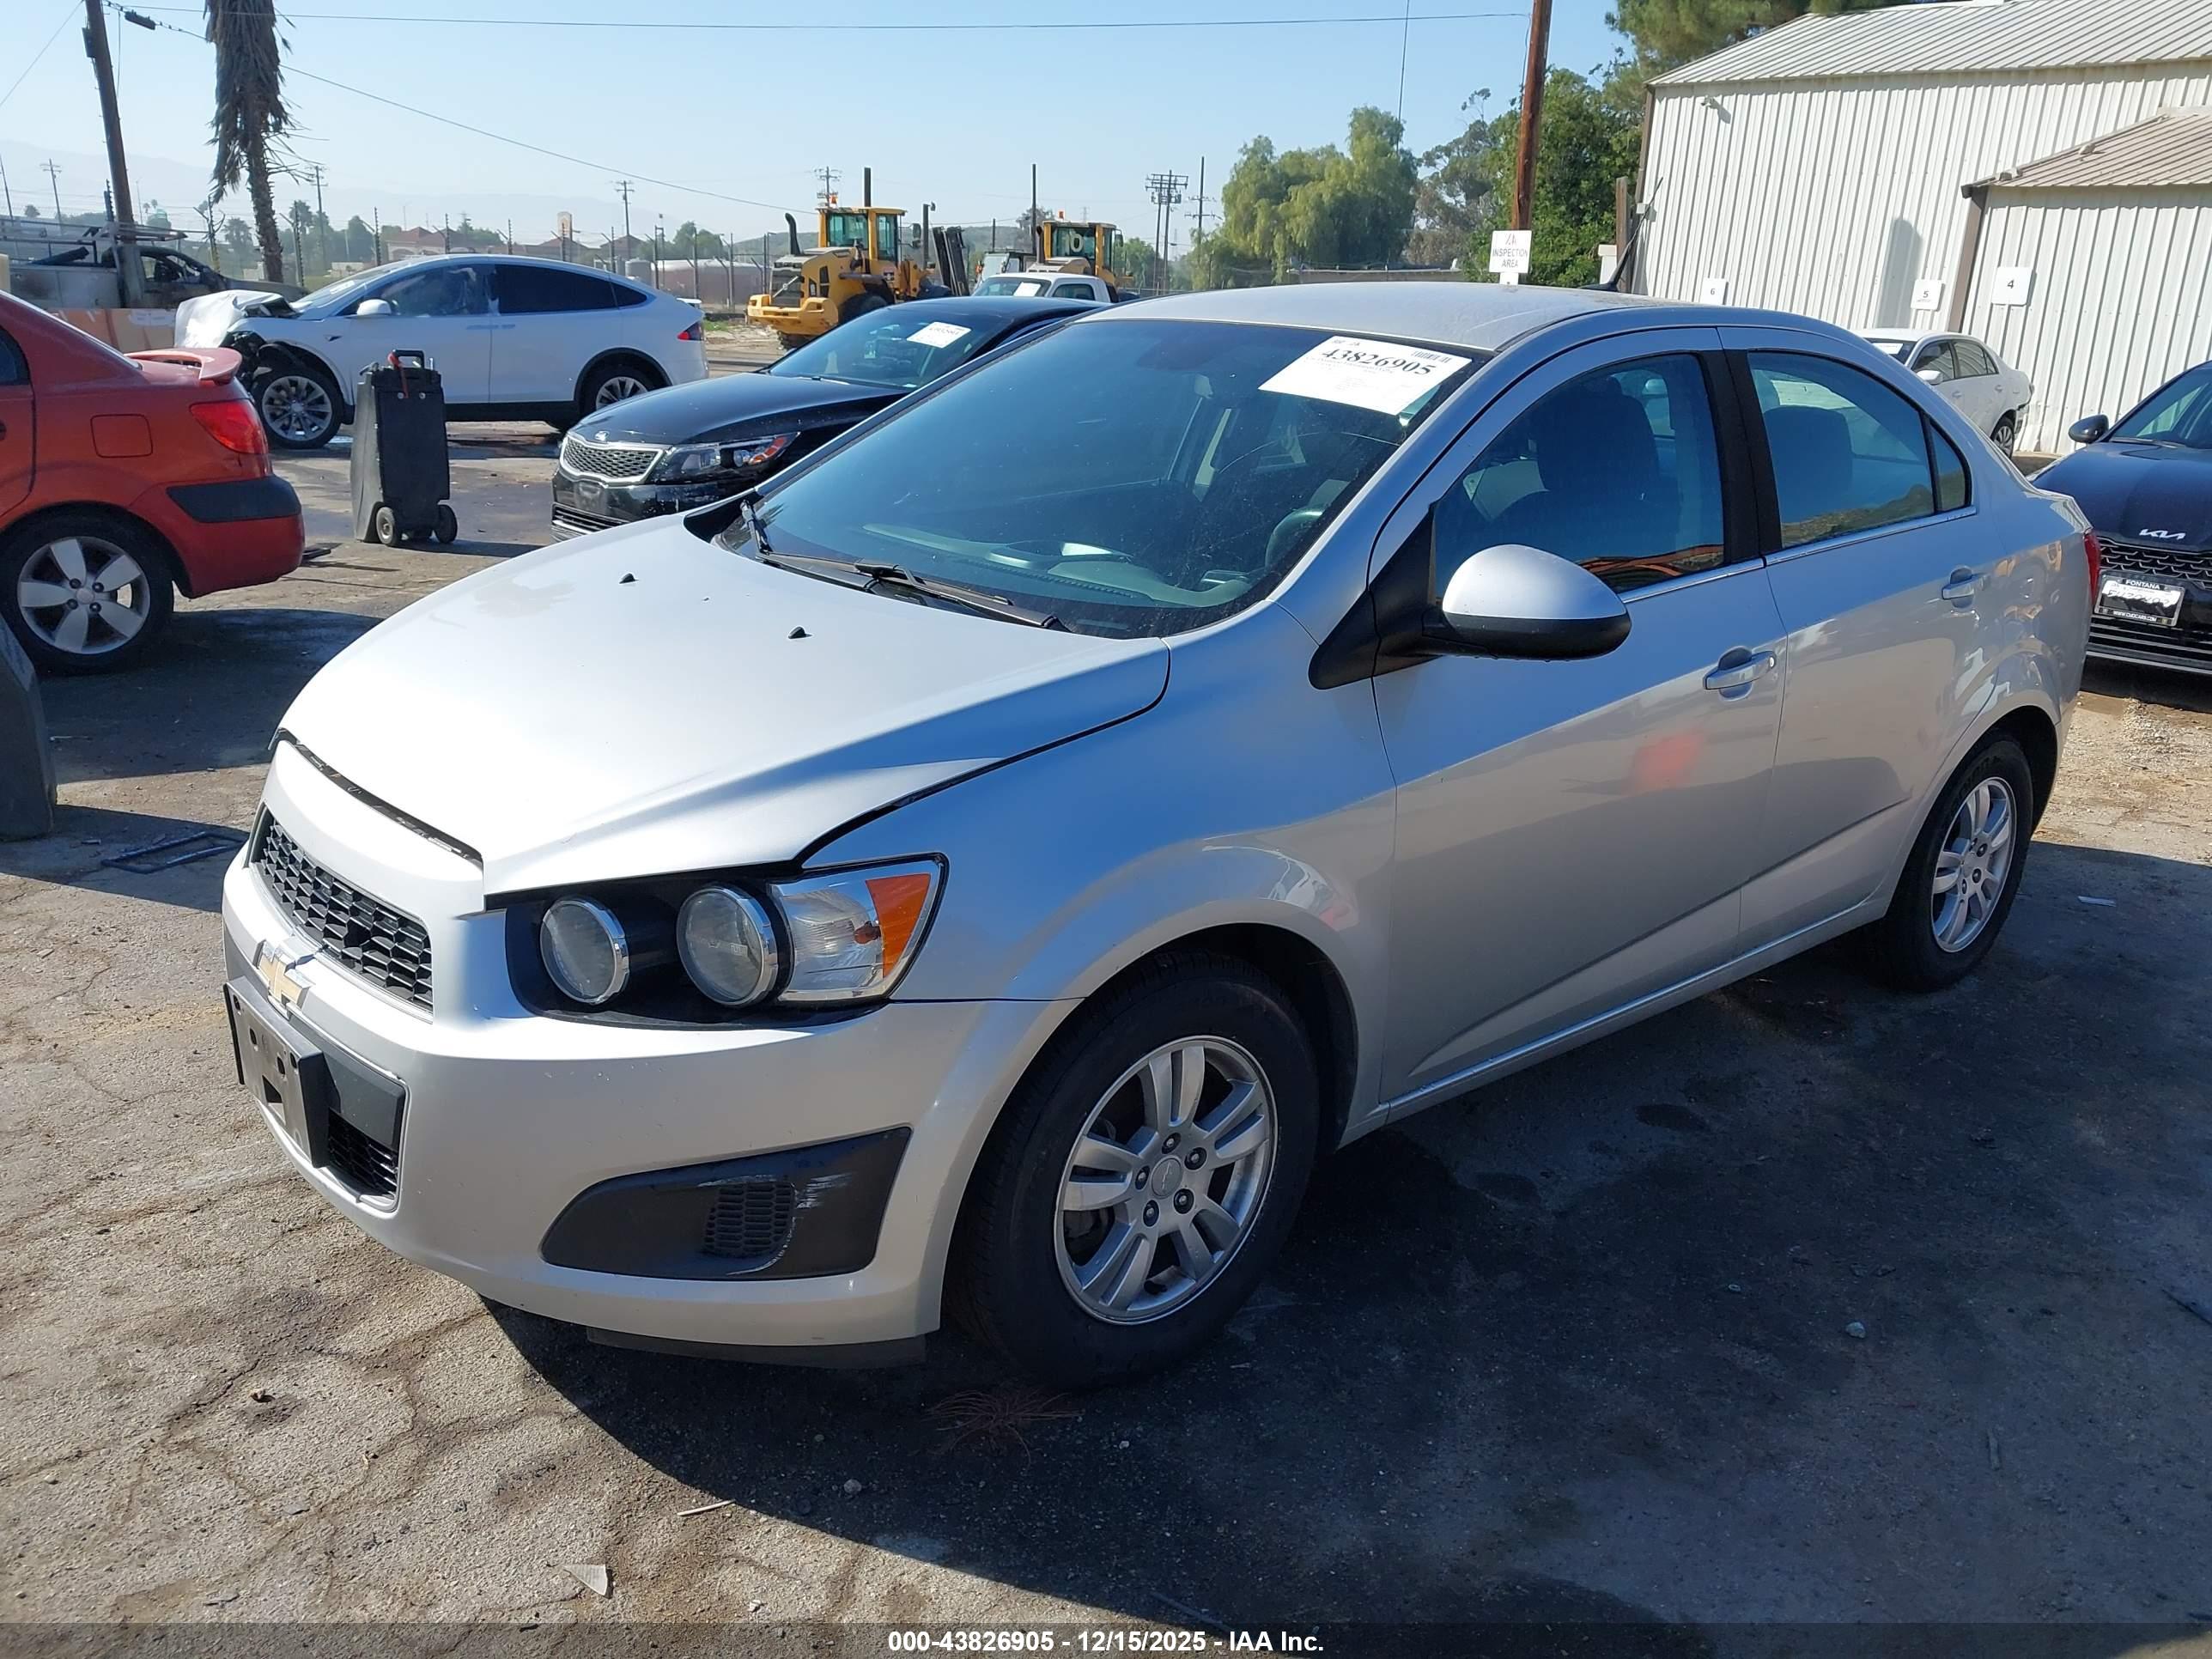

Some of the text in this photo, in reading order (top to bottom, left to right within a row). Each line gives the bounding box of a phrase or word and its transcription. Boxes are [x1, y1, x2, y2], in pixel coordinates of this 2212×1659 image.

[1492, 248, 1528, 258] INSPECTION
[1502, 258, 1519, 268] AREA
[2007, 279, 2014, 289] 4
[1923, 290, 1929, 299] 5
[1322, 348, 1437, 375] 43826905
[2125, 579, 2160, 590] FONTANA
